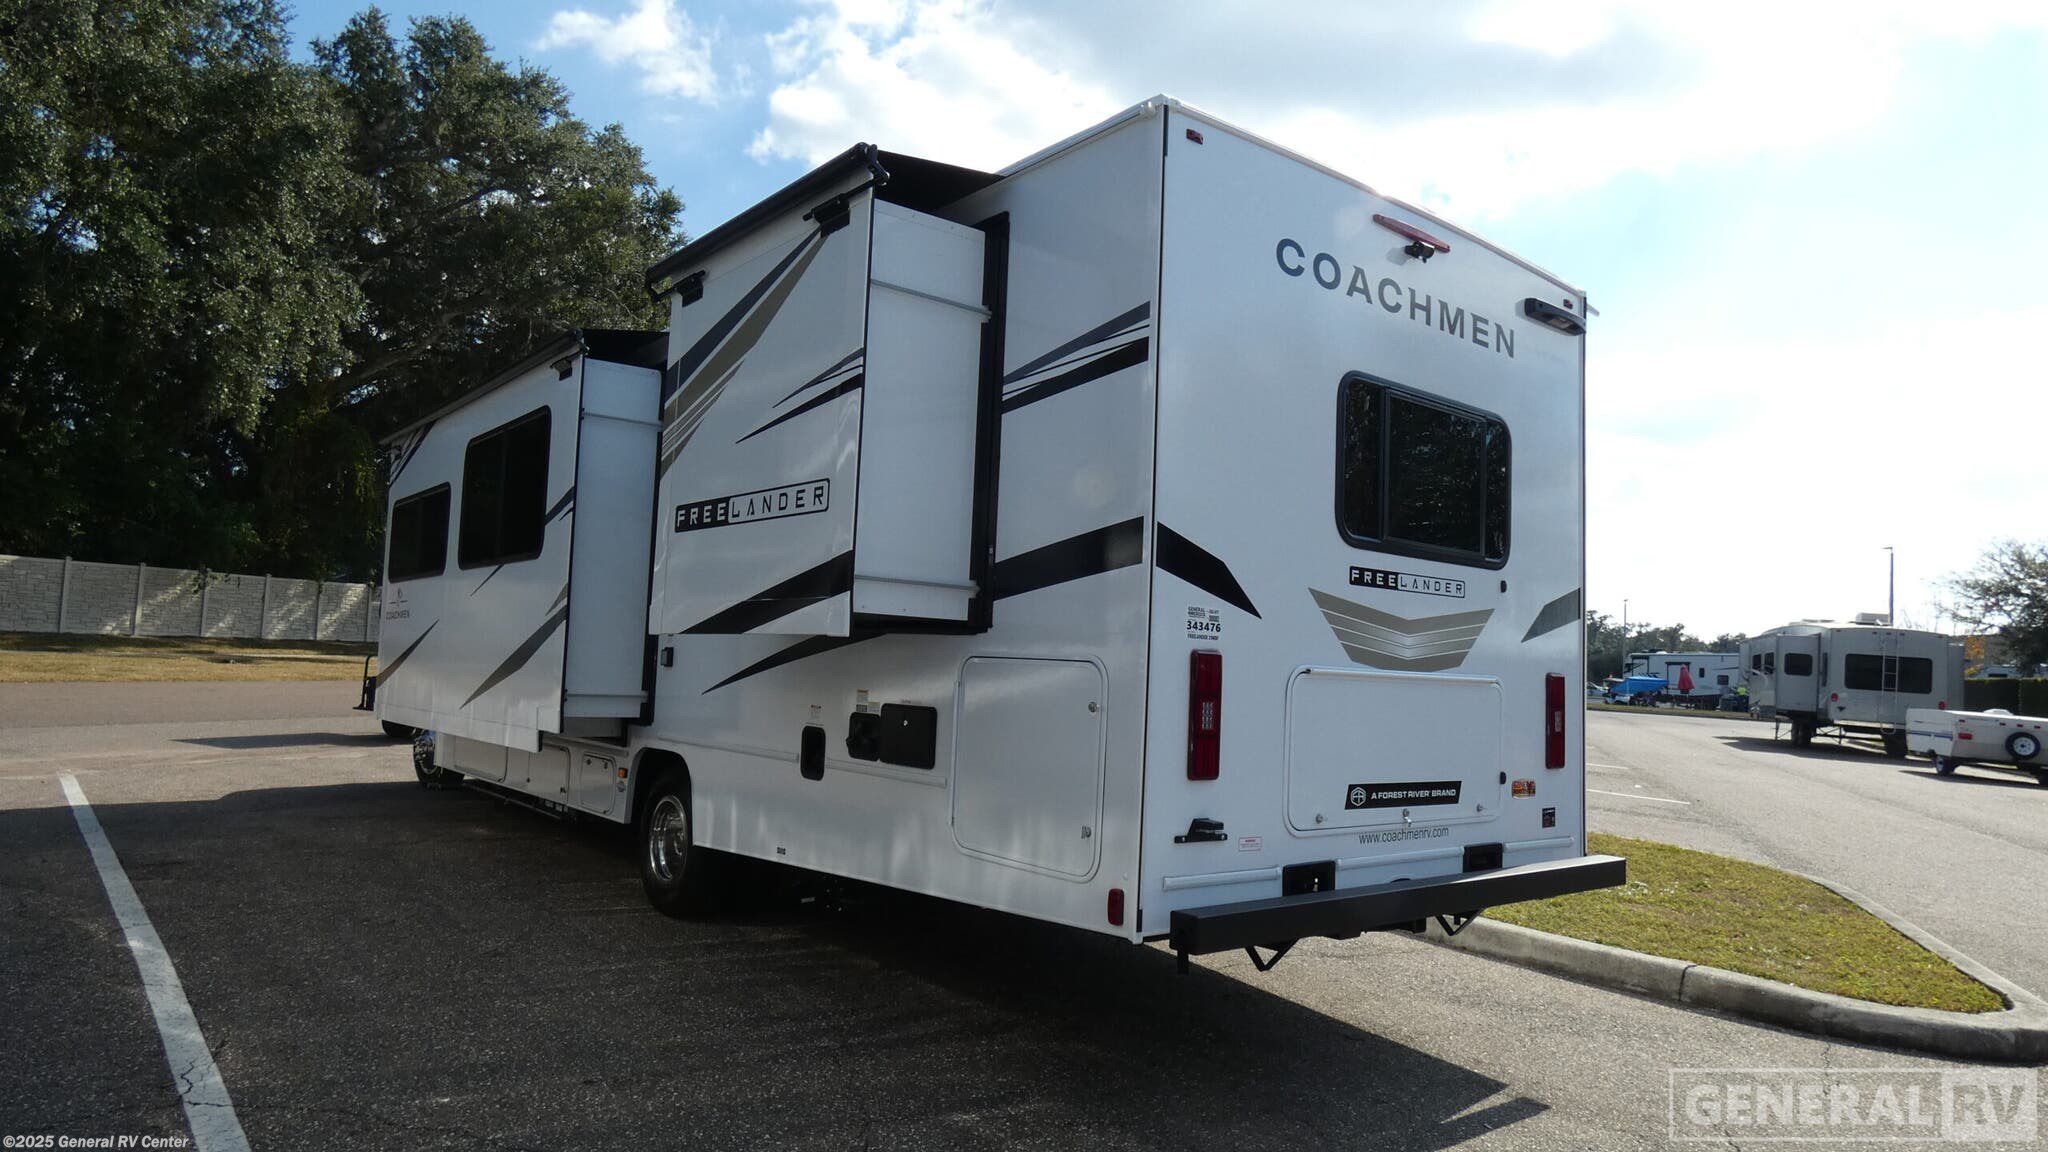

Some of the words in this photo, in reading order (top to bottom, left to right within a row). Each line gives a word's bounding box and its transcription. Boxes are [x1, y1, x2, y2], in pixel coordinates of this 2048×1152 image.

[1276, 238, 1515, 358] COACHMEN
[677, 485, 825, 527] FREELANDER
[1351, 569, 1463, 594] FREELANDER
[1187, 620, 1221, 632] 343476
[1378, 791, 1407, 799] FOREST
[1431, 789, 1456, 797] BRAND
[1359, 826, 1449, 844] www.coachmenrv.com
